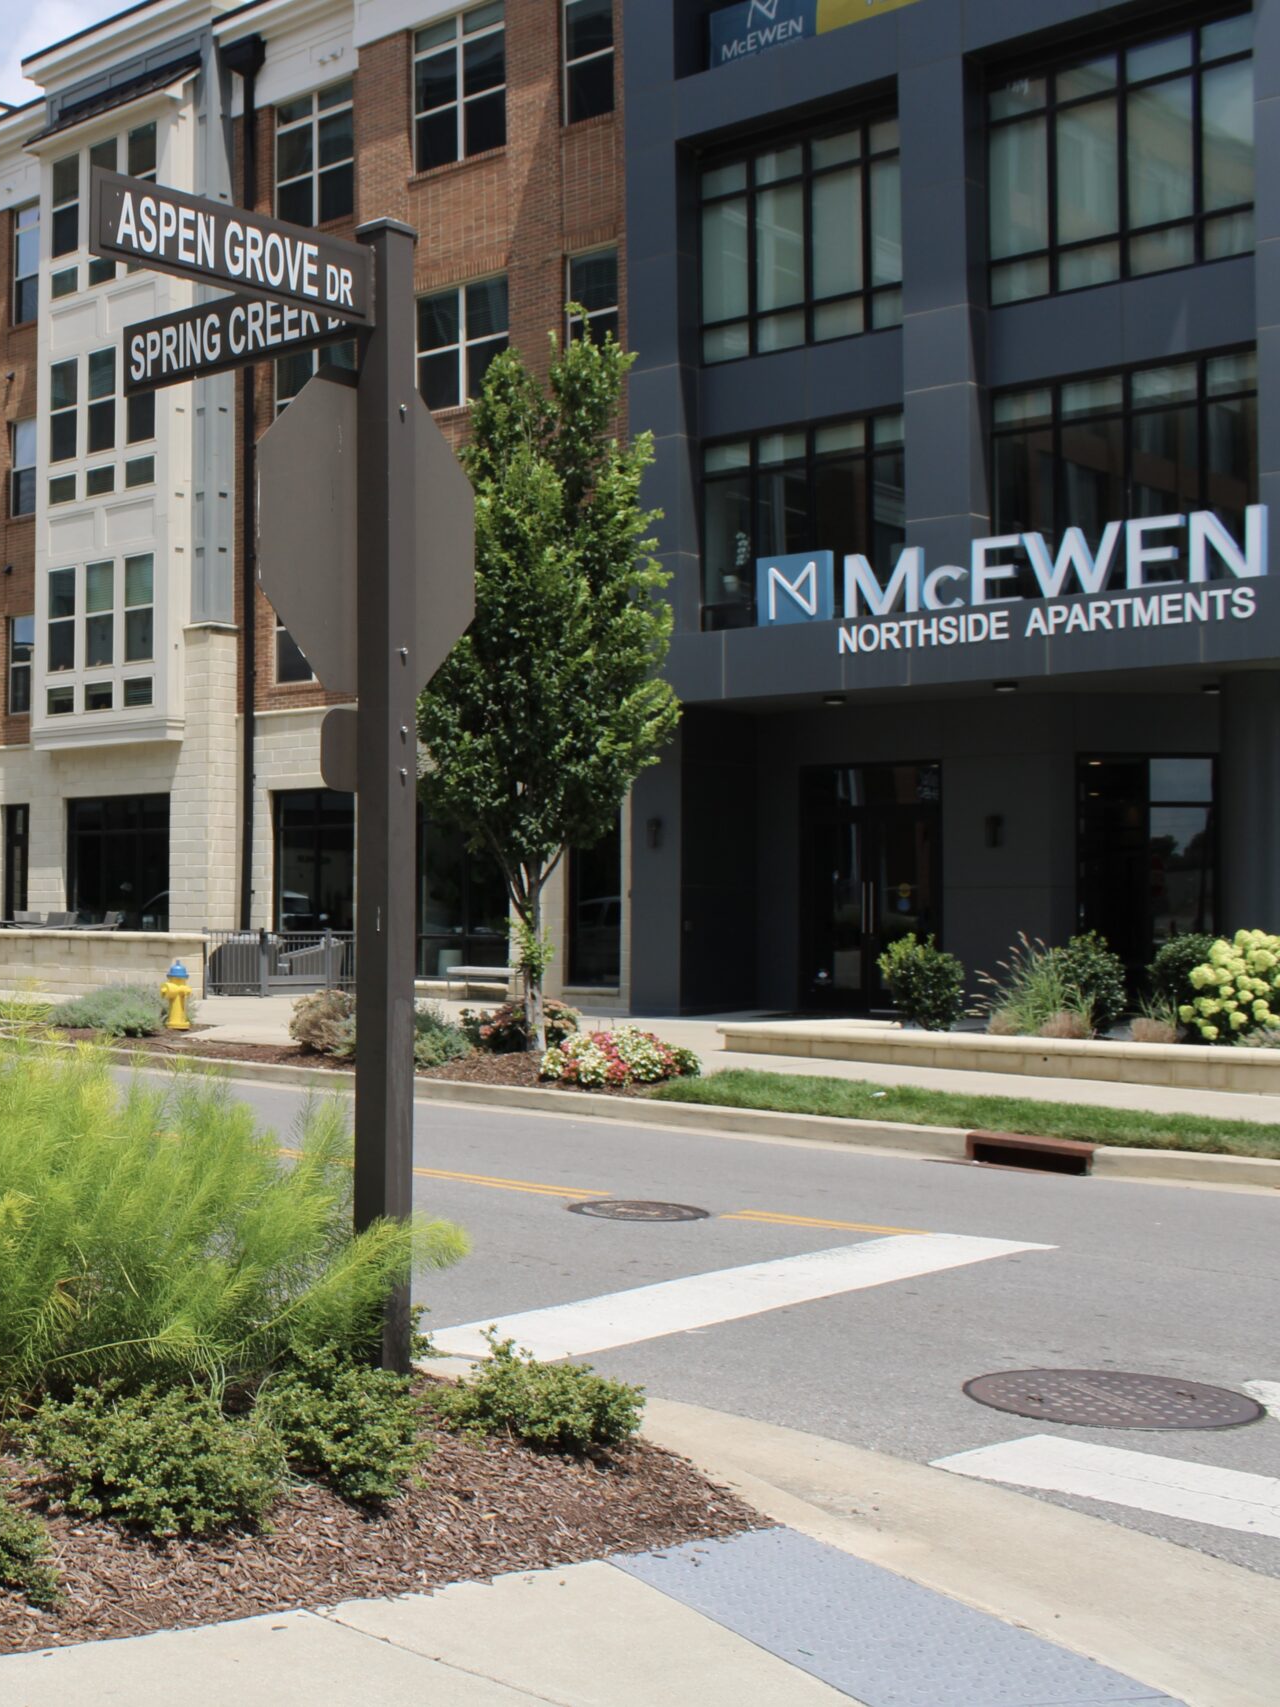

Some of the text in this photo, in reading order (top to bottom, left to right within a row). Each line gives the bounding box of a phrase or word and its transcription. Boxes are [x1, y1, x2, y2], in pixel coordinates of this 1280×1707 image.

[721, 16, 803, 61] McEWEN
[117, 191, 353, 306] ASPEN GROVE DR
[130, 313, 220, 381] SPRING
[844, 504, 1268, 618] McEWEN
[838, 586, 1256, 654] NORTHSIDE APARTMENTS
